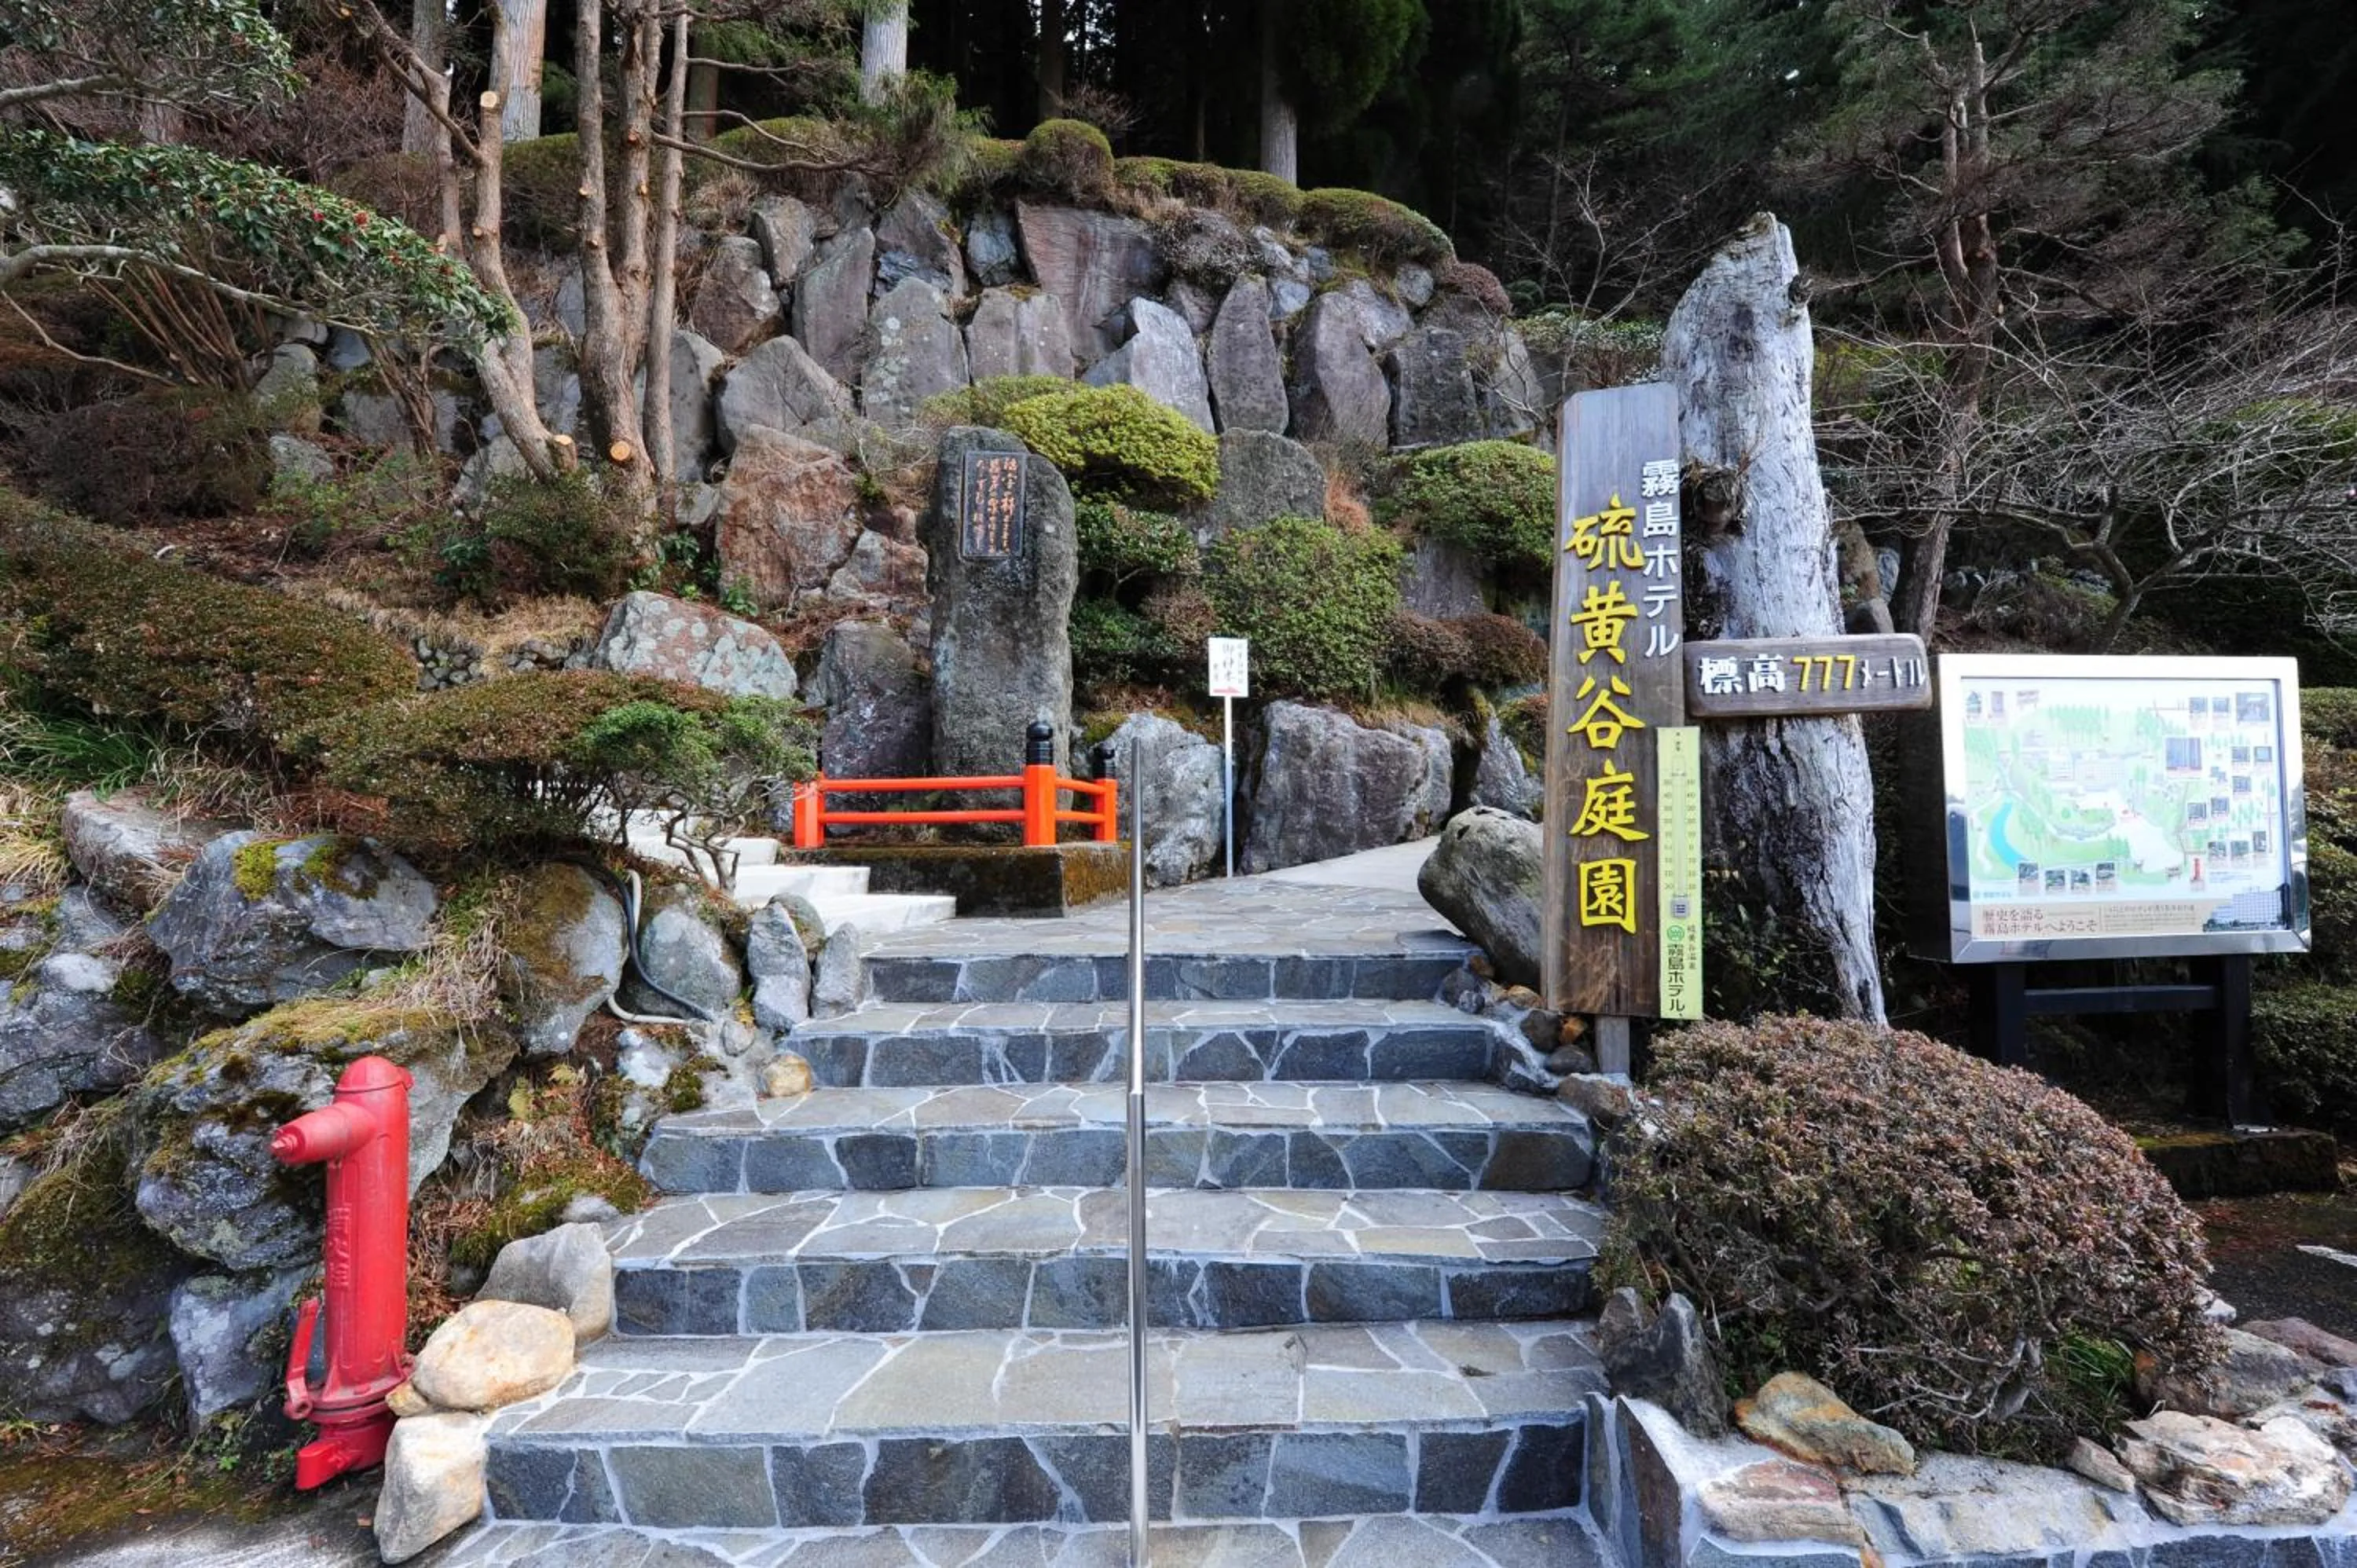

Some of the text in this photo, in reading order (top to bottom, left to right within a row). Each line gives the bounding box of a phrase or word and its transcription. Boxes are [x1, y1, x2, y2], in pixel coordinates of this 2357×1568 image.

[1641, 459, 1679, 658] 霧島ホテル
[1564, 493, 1650, 934] 硫黄谷庭園
[1699, 653, 1925, 694] 標高777メートル
[1667, 943, 1685, 1012] 霧島ホテル
